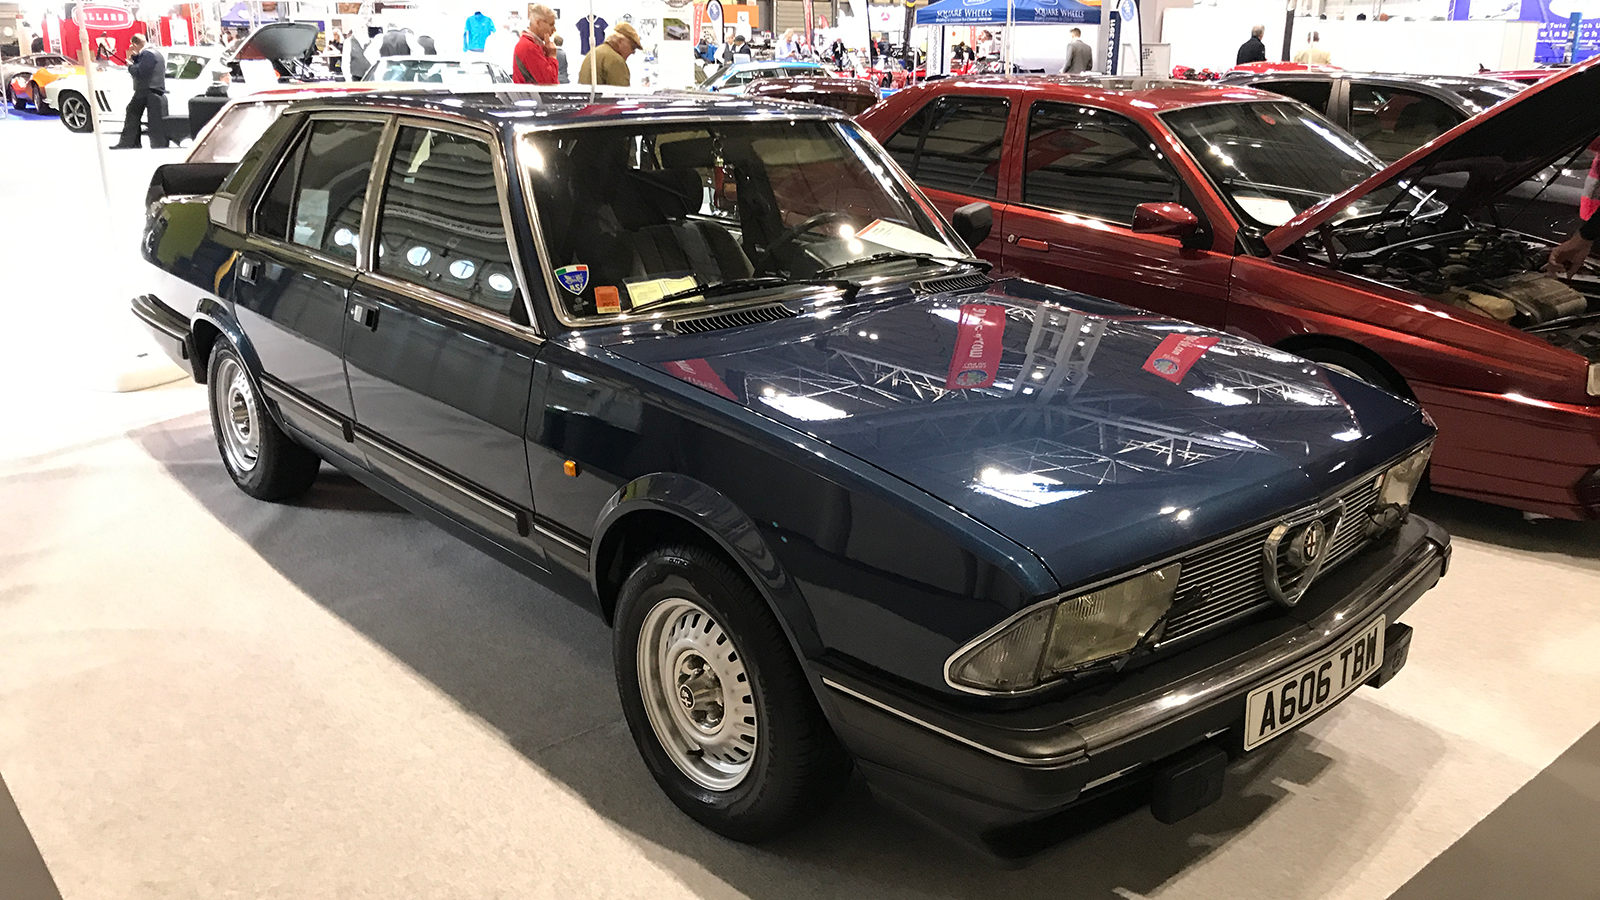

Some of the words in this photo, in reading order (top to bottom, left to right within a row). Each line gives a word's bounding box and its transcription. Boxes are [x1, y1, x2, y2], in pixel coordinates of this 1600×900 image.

[936, 9, 962, 18] SQUARE
[964, 8, 993, 17] WHEELS
[1034, 8, 1059, 16] SQUARE
[1060, 9, 1085, 18] WHEELS
[1258, 661, 1333, 737] A606
[1340, 627, 1378, 689] TBW
